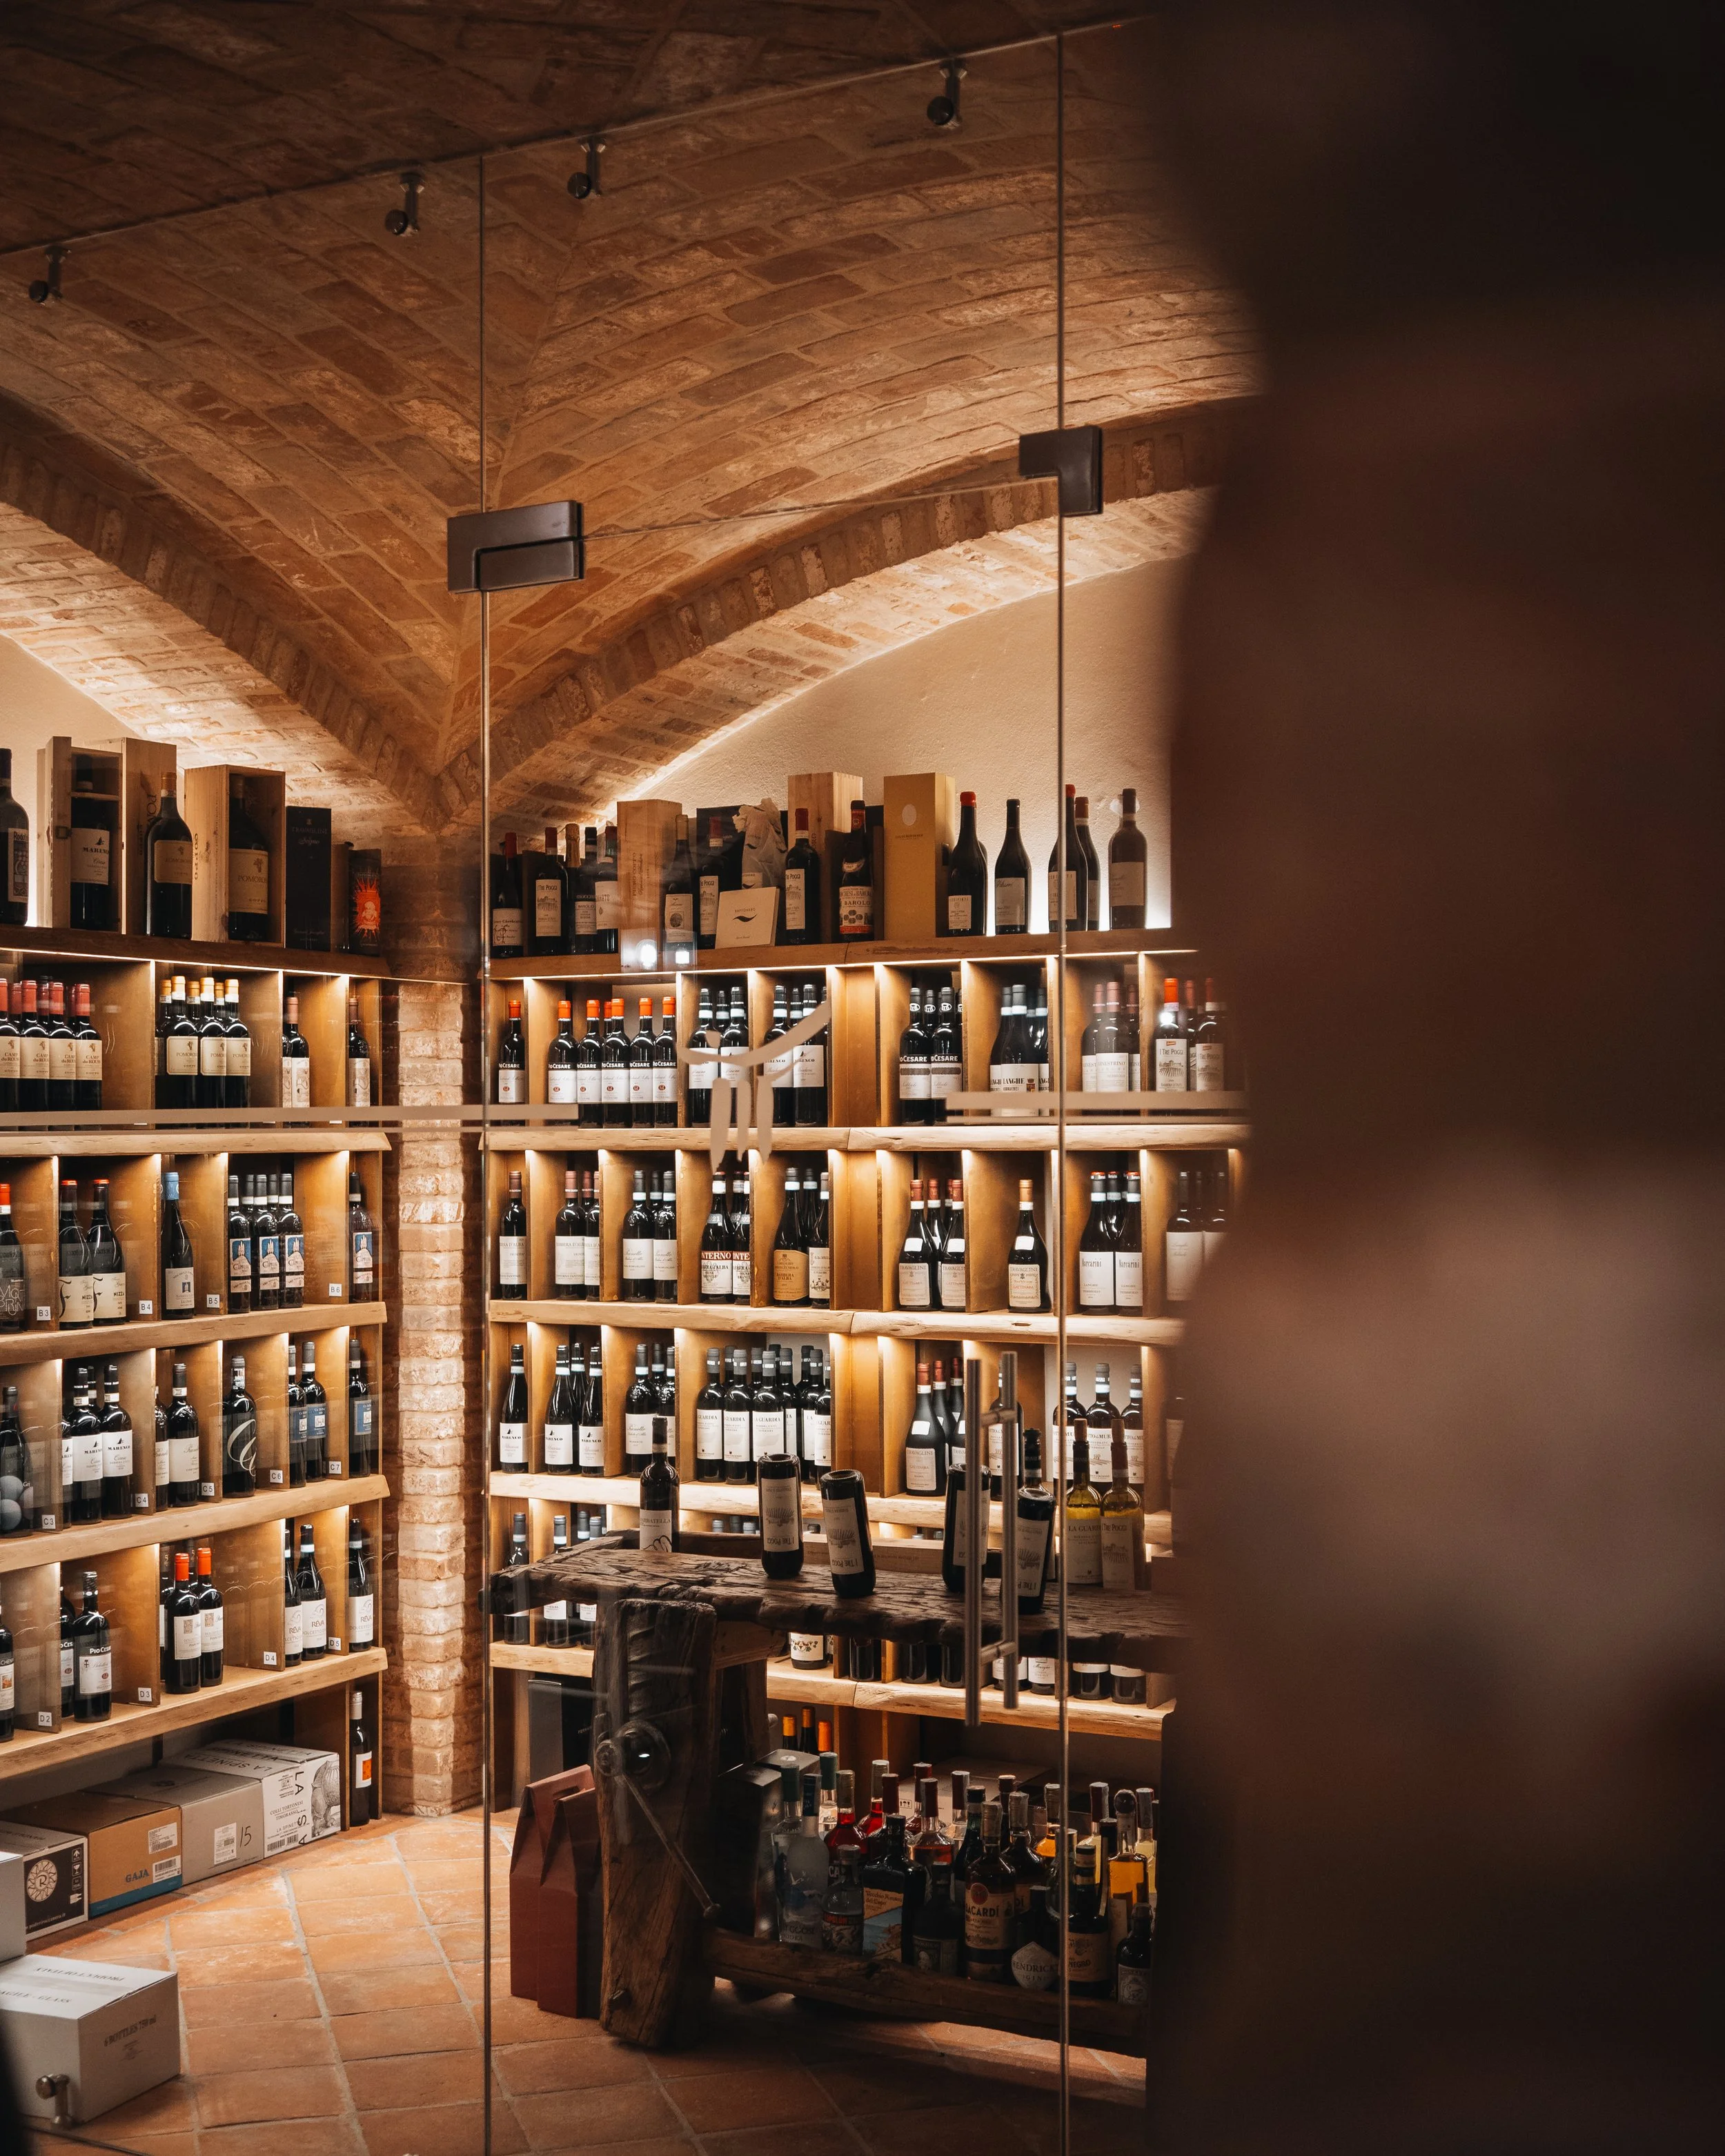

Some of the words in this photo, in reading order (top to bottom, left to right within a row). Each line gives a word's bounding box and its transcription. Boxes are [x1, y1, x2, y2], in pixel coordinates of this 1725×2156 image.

[276, 1808, 298, 1821] TIMORASSO
[239, 1825, 253, 1848] 15
[125, 1868, 150, 1883] GAJA
[866, 1890, 885, 1899] Vecchio
